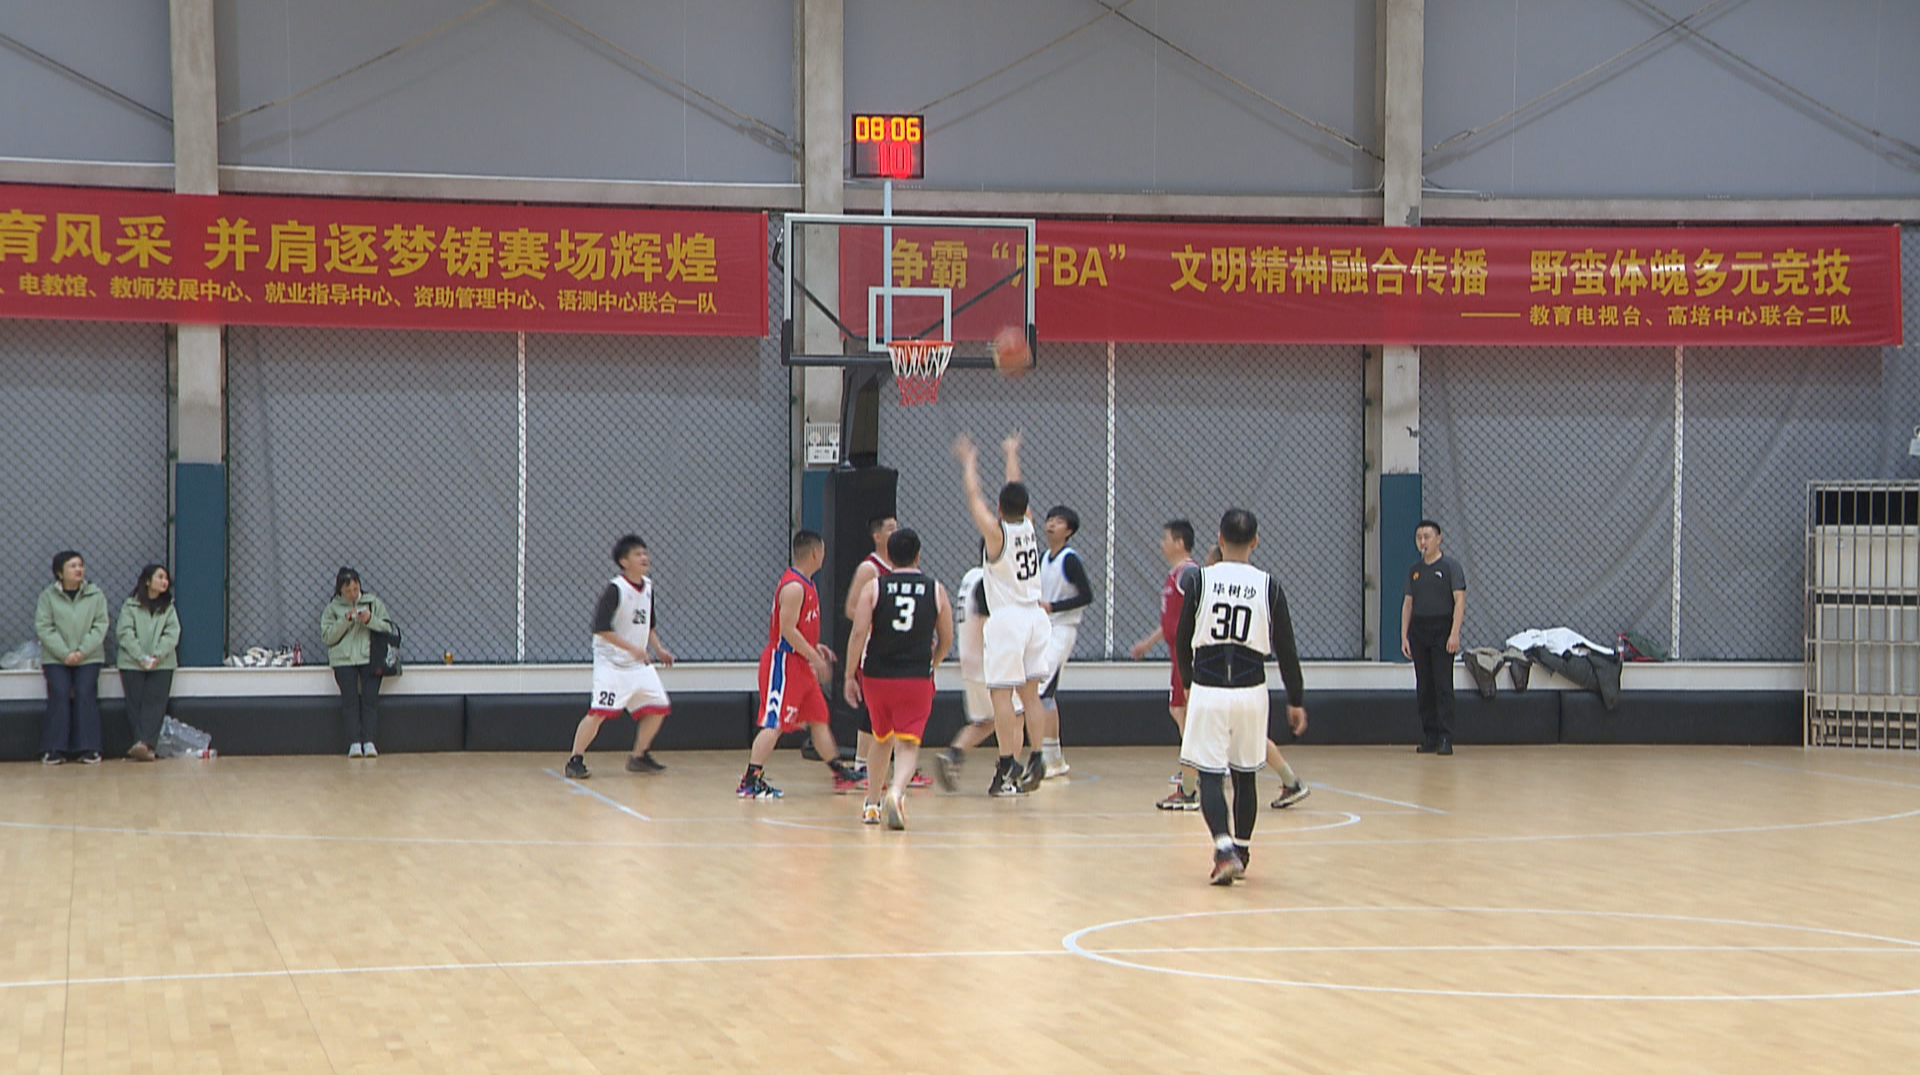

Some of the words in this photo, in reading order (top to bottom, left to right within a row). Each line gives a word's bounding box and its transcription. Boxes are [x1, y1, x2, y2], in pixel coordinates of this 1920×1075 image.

[855, 116, 920, 142] 08:06
[204, 217, 719, 283] 并肩逐梦铸赛场辉煌
[1170, 244, 1489, 296] 文明精神融合传播
[1529, 248, 1852, 297] 野蛮体魄多元竞技
[1529, 304, 1852, 327] 教育电视台、高培中心联合二队
[1016, 549, 1037, 581] 33
[892, 595, 916, 631] 3
[1211, 602, 1252, 643] 30
[599, 691, 616, 706] 26
